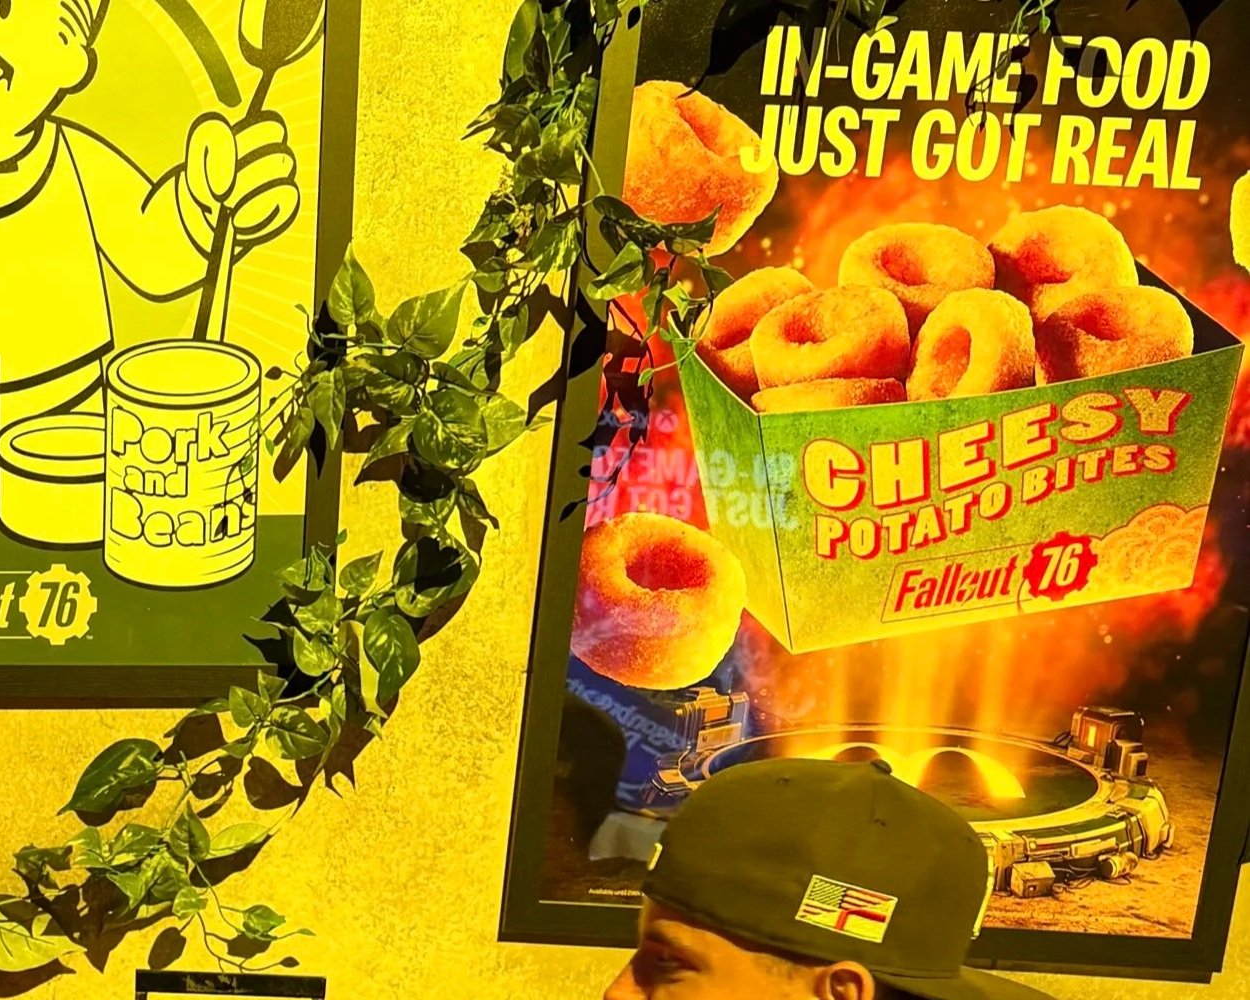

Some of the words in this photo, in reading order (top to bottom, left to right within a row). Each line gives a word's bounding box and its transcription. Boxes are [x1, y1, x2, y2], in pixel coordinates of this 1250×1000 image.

[760, 25, 1030, 104] IN-GAME
[1043, 35, 1210, 110] FOOD
[740, 104, 900, 177] JUST
[911, 109, 1042, 184] GOT
[1052, 115, 1202, 190] REAL
[111, 405, 230, 464] Pork
[802, 386, 1192, 511] CHEESY
[123, 464, 188, 497] and
[815, 481, 1012, 560] POTATO
[1021, 443, 1177, 505] BITES
[38, 581, 80, 628] 76
[894, 554, 1020, 613] Fallout
[1038, 543, 1082, 591] 76
